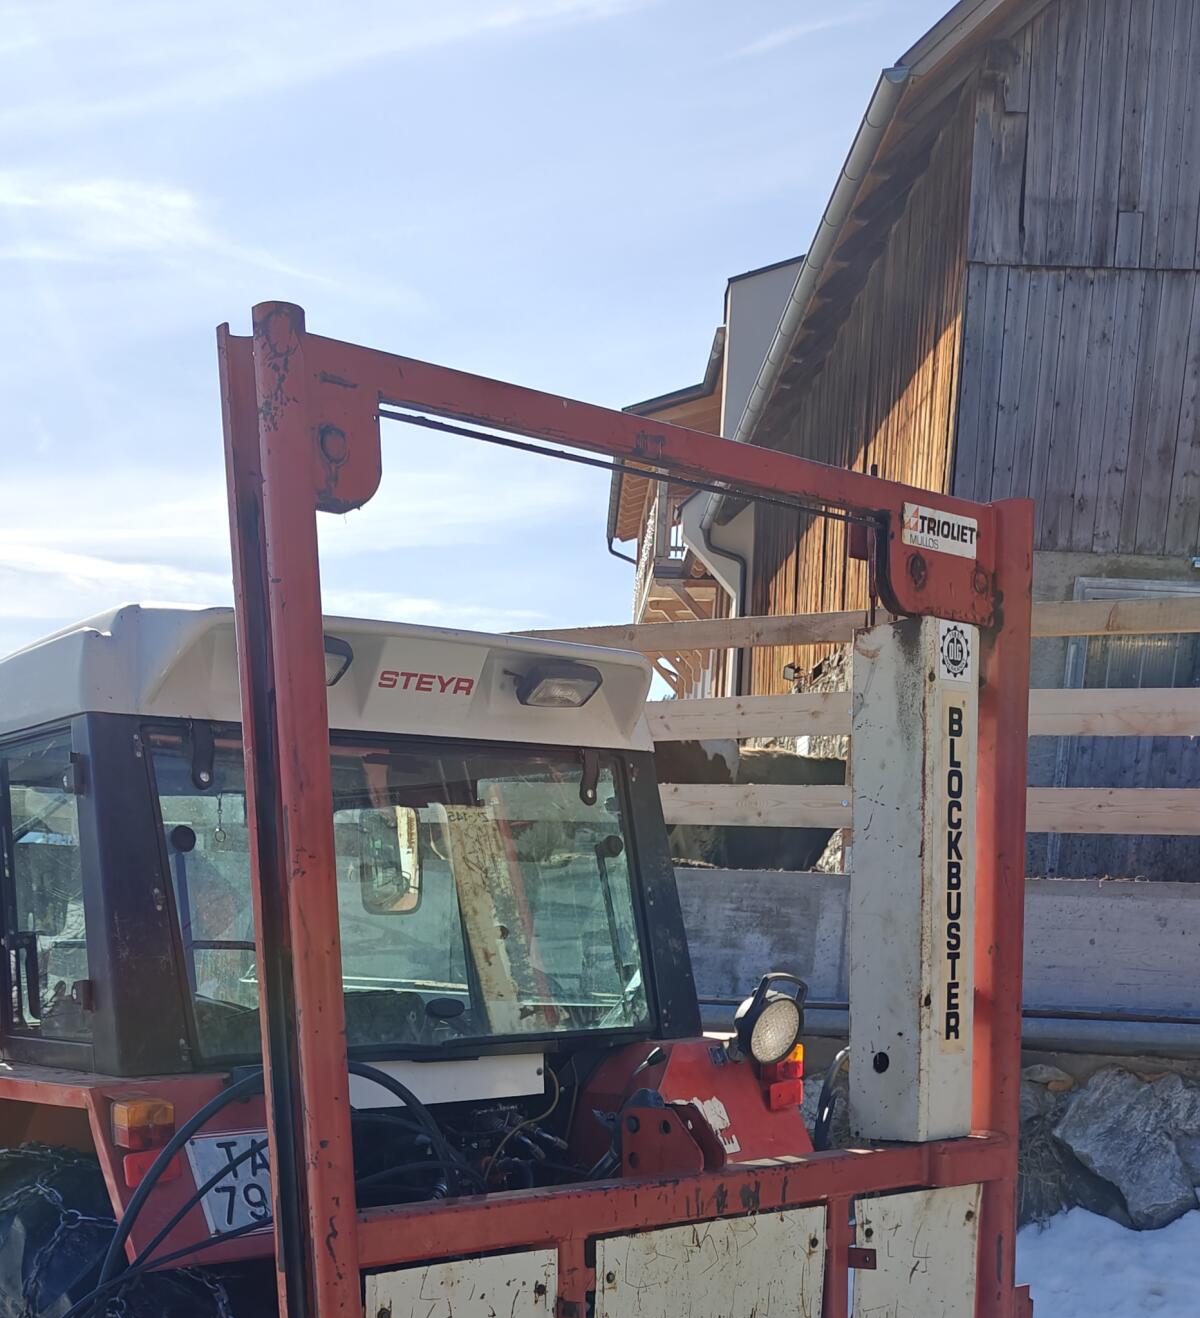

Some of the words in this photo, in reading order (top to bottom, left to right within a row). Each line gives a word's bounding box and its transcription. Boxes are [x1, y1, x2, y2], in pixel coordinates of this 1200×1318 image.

[909, 533, 939, 549] MULLOS
[919, 515, 976, 545] TRIOLIET
[378, 670, 474, 695] STEYR
[945, 706, 963, 1040] BLOCKBUSTER
